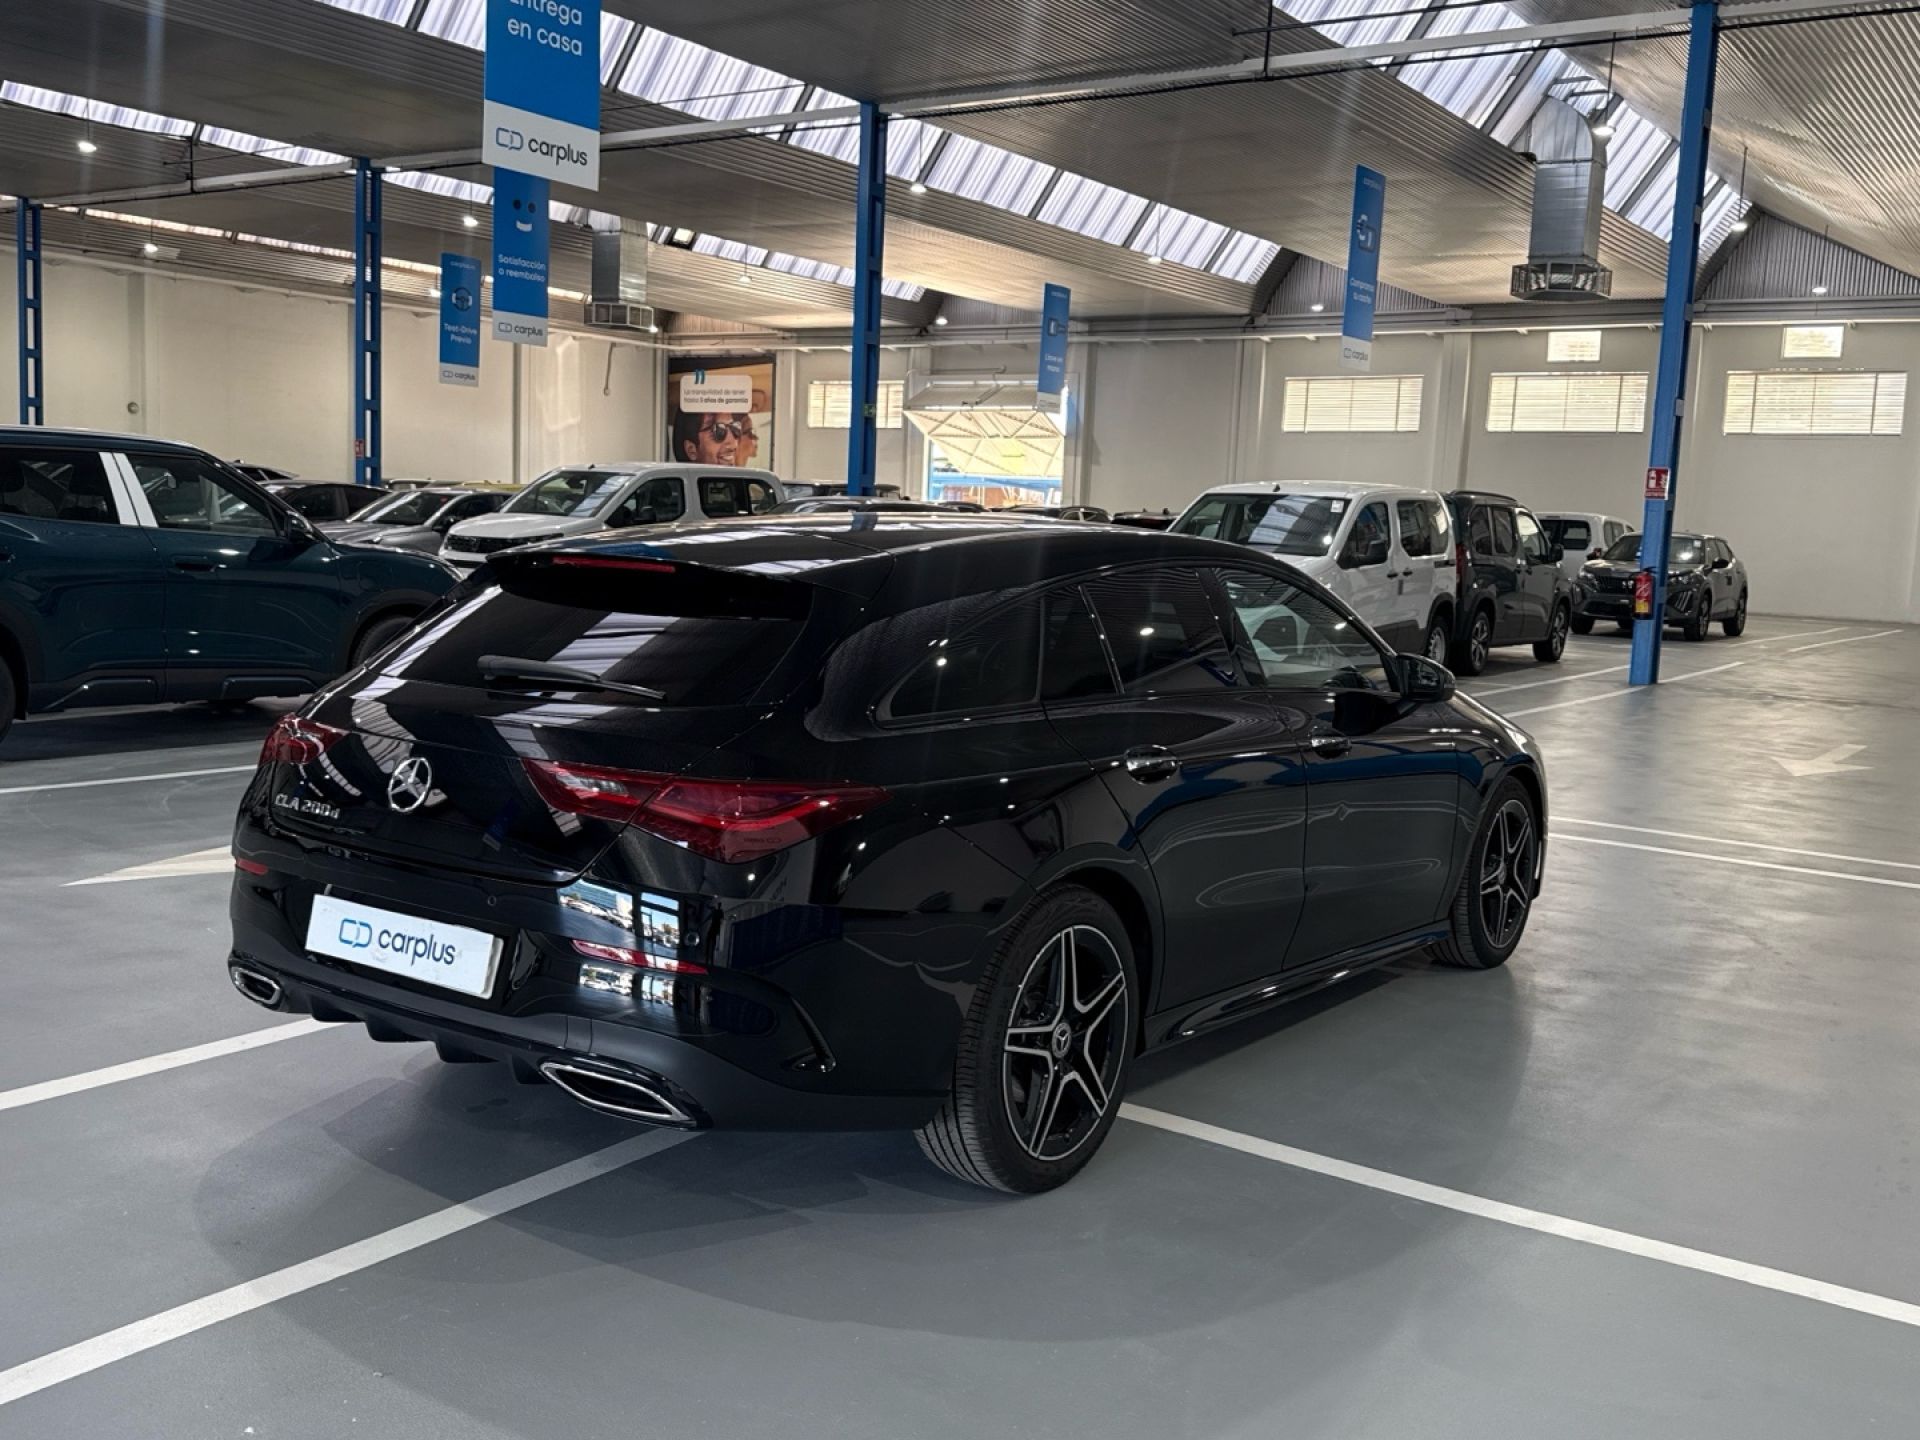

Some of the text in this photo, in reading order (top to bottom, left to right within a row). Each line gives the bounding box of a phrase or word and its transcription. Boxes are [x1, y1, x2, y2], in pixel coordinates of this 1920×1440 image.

[507, 18, 582, 56] en casa
[528, 138, 588, 166] carplus
[498, 254, 546, 271] Satisfacción
[498, 267, 546, 283] o reembolso
[514, 324, 543, 338] carplus
[454, 373, 476, 381] carplus
[275, 793, 300, 811] CLA
[378, 929, 456, 966] carplus
